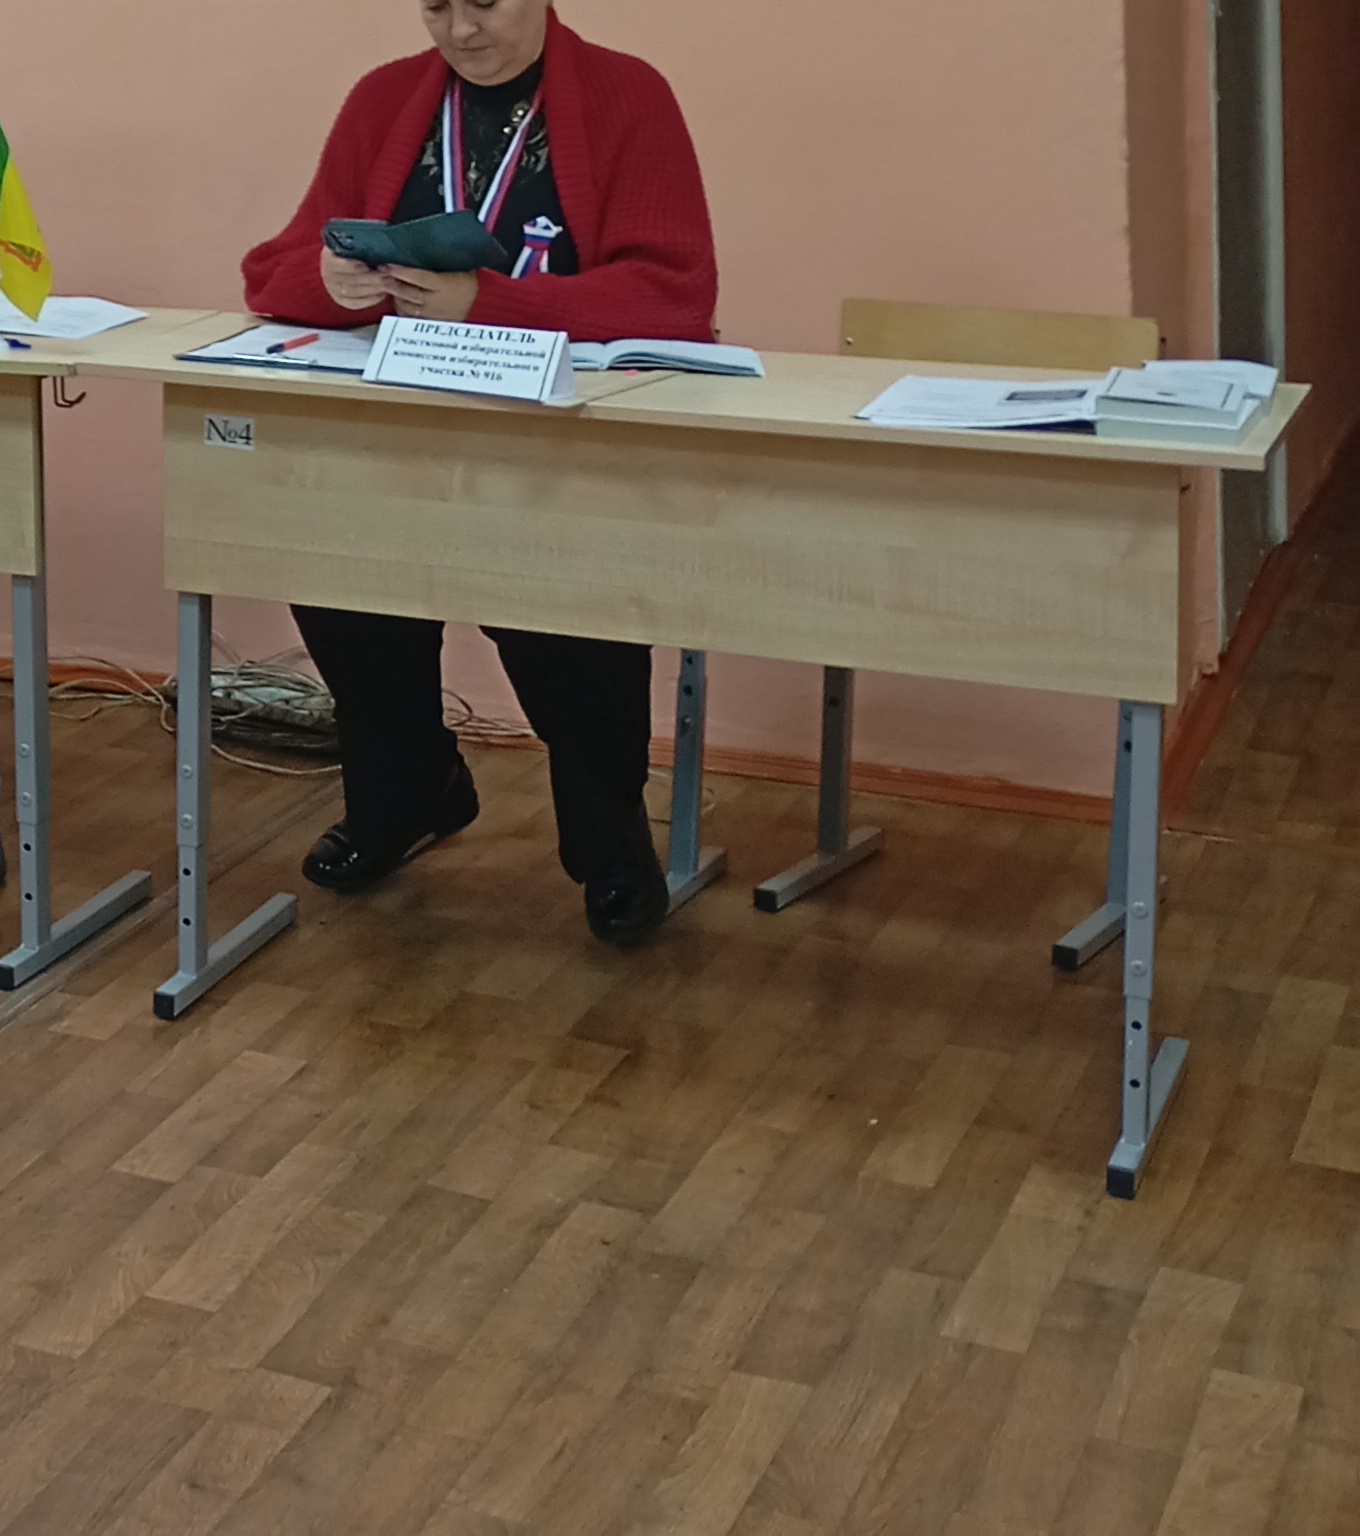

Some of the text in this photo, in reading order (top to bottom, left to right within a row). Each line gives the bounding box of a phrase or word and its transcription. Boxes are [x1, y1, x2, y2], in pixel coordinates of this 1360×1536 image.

[413, 322, 536, 344] ПРЕДСЕДАТЕЛЬ
[394, 337, 546, 359] участковой избирательной
[393, 349, 539, 372] комиссии избирательного
[419, 365, 465, 377] участка
